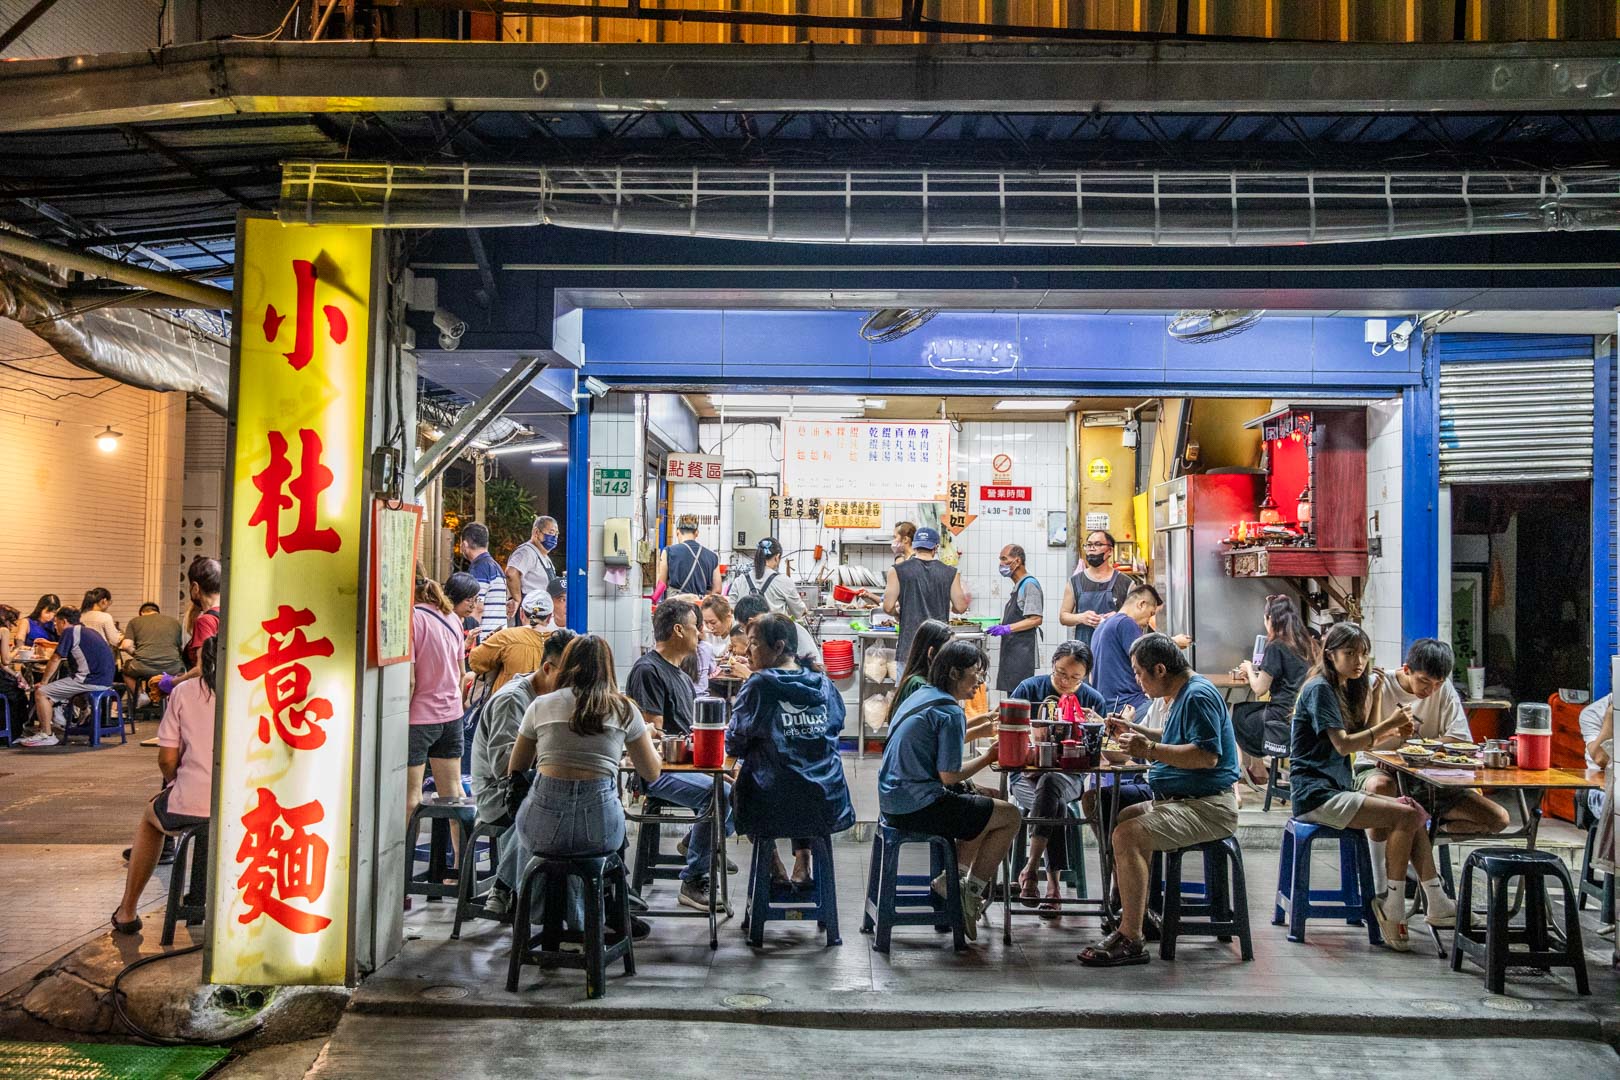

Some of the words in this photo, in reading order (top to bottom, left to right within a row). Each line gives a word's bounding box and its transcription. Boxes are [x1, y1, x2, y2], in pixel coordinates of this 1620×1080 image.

[907, 427, 917, 462] 魚丸湯
[668, 460, 722, 479] 點餐區
[604, 481, 629, 494] 143
[987, 488, 1026, 499] 營業時間
[236, 258, 348, 935] 小杜意麵
[781, 712, 824, 727] Dulux
[783, 727, 800, 737] let's
